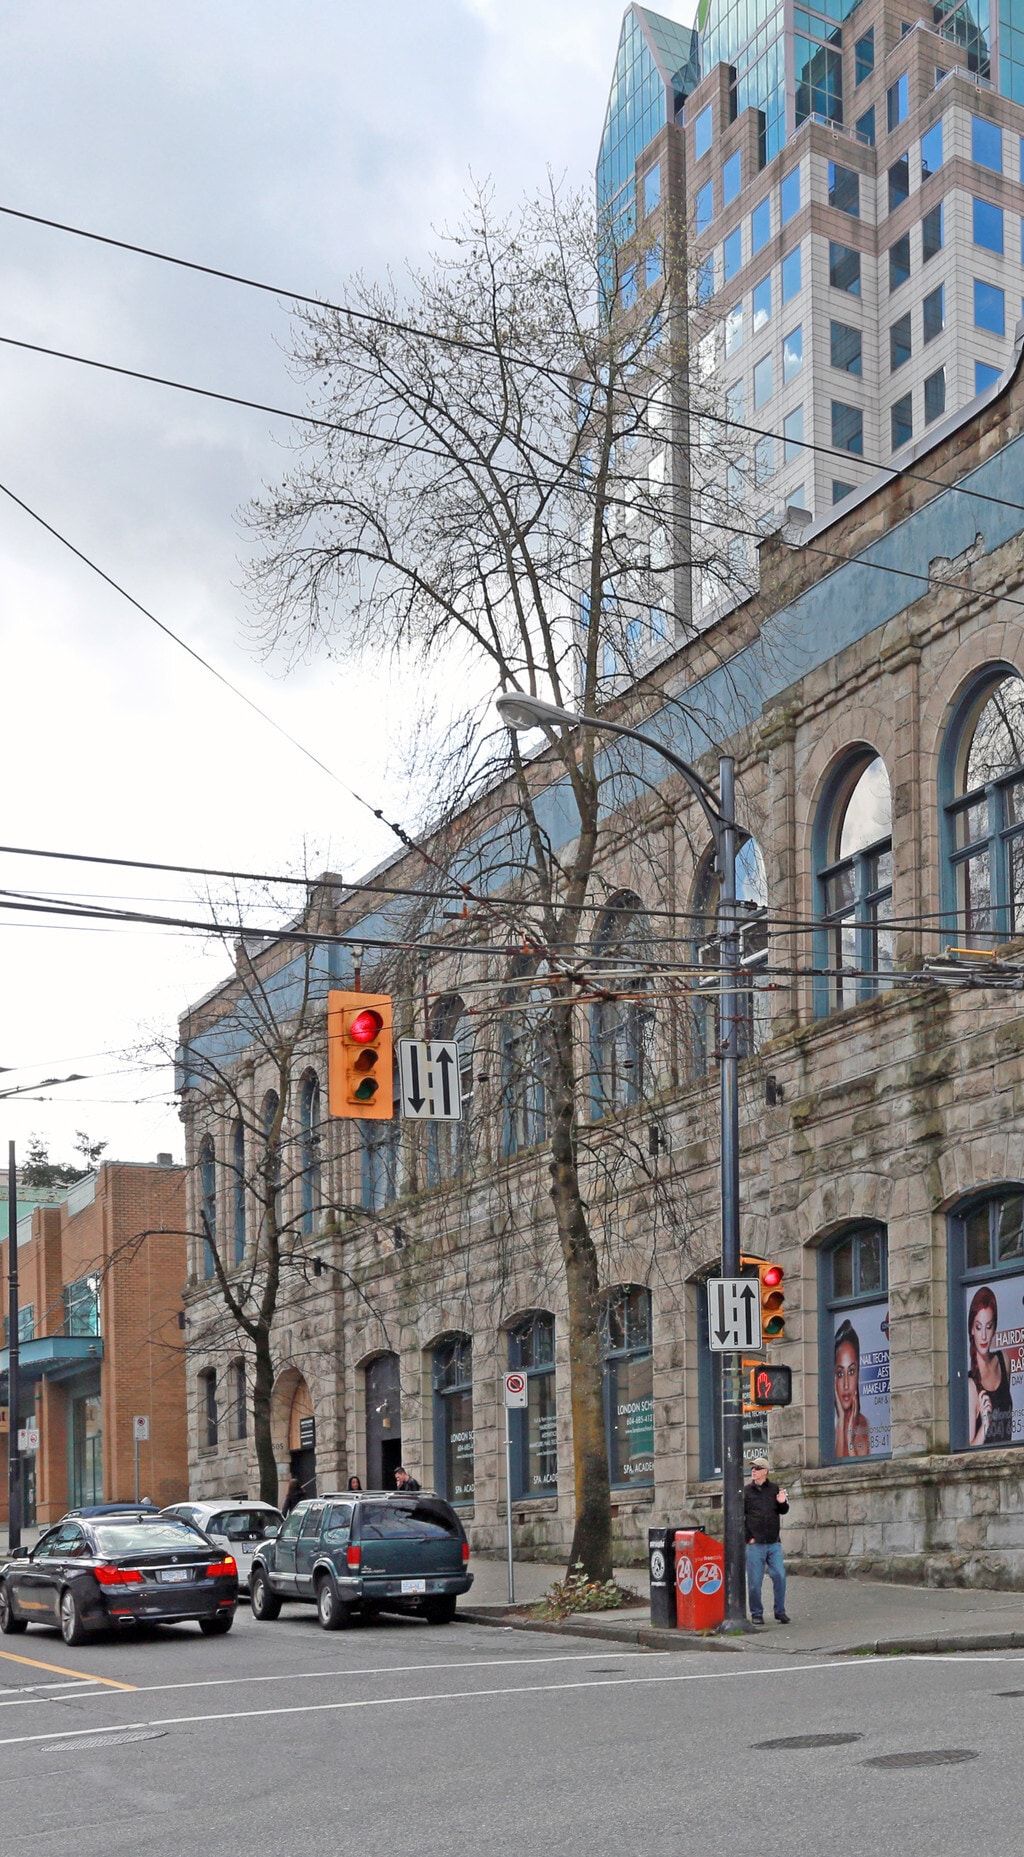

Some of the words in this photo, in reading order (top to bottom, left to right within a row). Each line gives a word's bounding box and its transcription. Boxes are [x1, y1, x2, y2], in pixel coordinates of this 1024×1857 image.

[1012, 1374, 1024, 1386] DAY
[617, 1402, 641, 1416] LONDON
[623, 1464, 634, 1475] SPA
[678, 1558, 692, 1579] 24
[699, 1564, 719, 1582] 24
